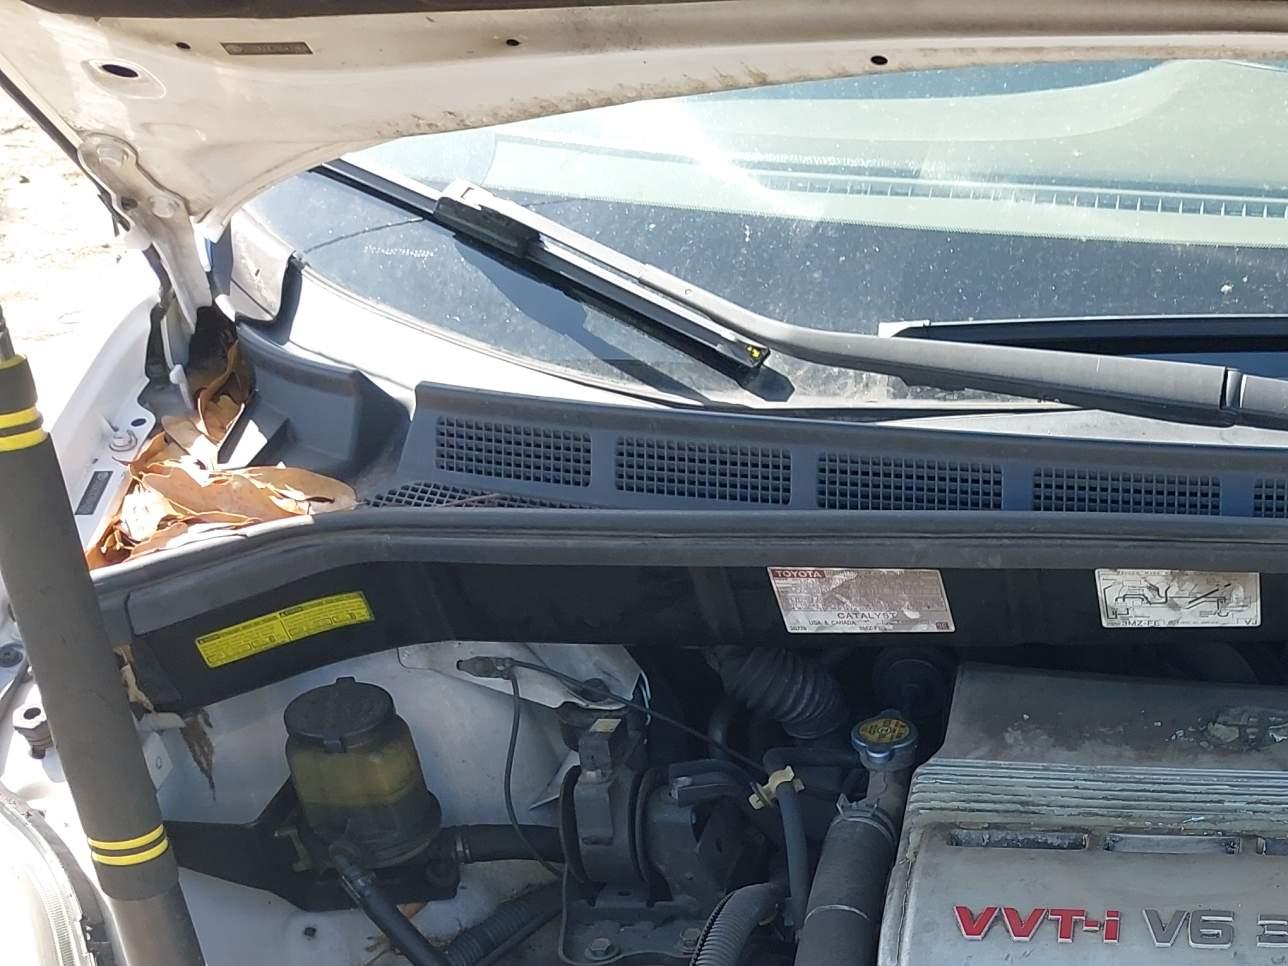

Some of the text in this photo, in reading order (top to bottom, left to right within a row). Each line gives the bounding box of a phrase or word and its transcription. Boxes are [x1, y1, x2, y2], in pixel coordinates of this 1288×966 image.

[775, 570, 822, 578] TOYOTA
[837, 612, 897, 620] CATALYST
[953, 905, 1121, 943] VVT-i
[1142, 909, 1235, 949] V6
